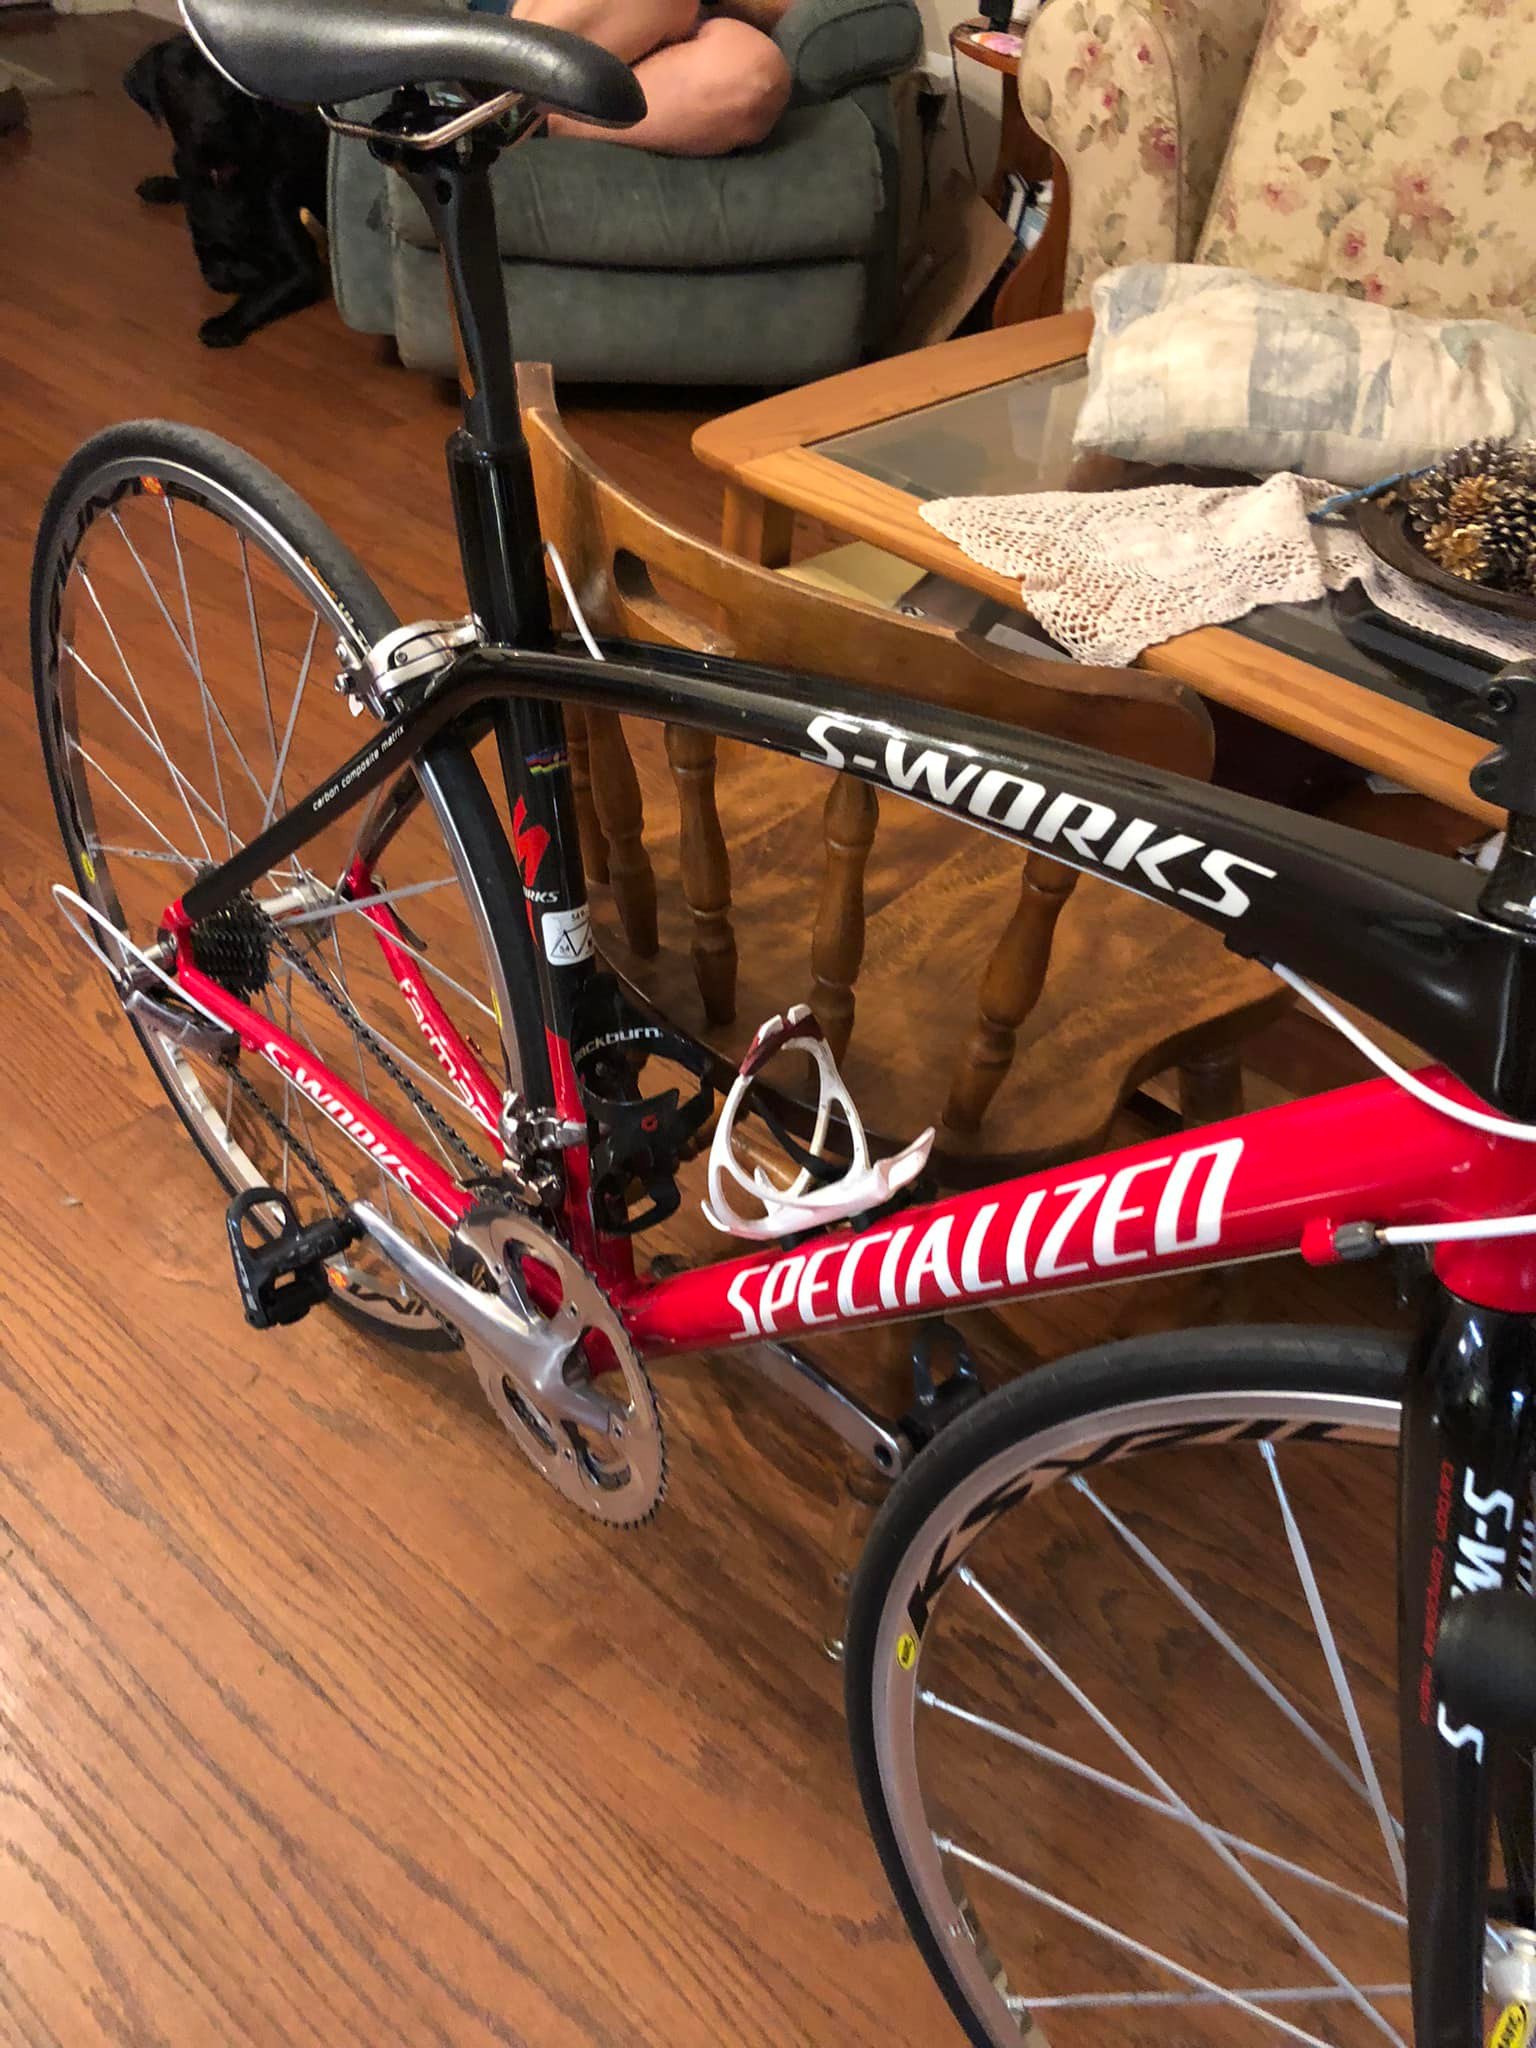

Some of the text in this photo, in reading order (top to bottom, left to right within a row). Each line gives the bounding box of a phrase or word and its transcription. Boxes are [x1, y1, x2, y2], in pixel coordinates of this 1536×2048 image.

[312, 724, 404, 812] carbon composite matrix
[806, 715, 1278, 918] S-WORKS
[727, 1137, 1254, 1340] SPECIALIZED
